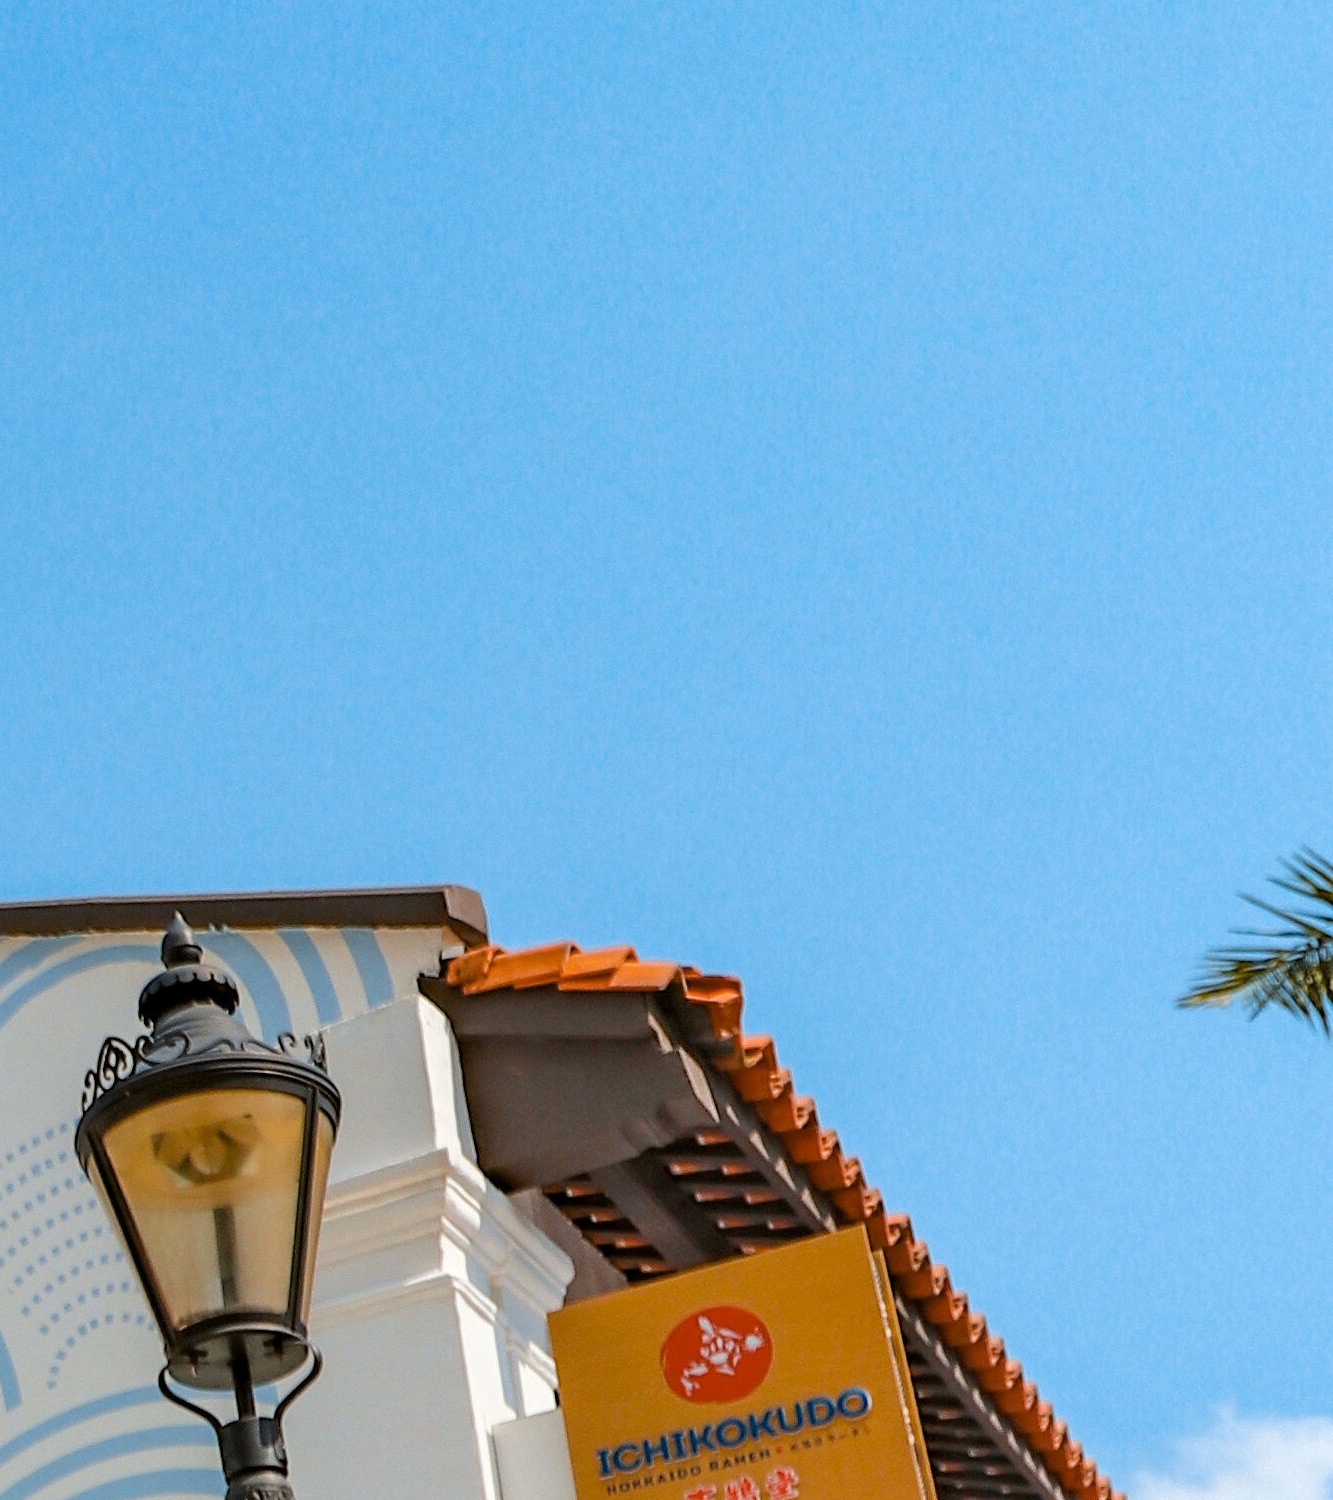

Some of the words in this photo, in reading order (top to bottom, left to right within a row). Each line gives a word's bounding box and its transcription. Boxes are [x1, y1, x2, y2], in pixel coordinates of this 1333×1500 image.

[596, 1386, 873, 1480] ICHIKOKUDO
[606, 1465, 702, 1496] HOKKAIDO
[708, 1449, 772, 1472] RAMEN
